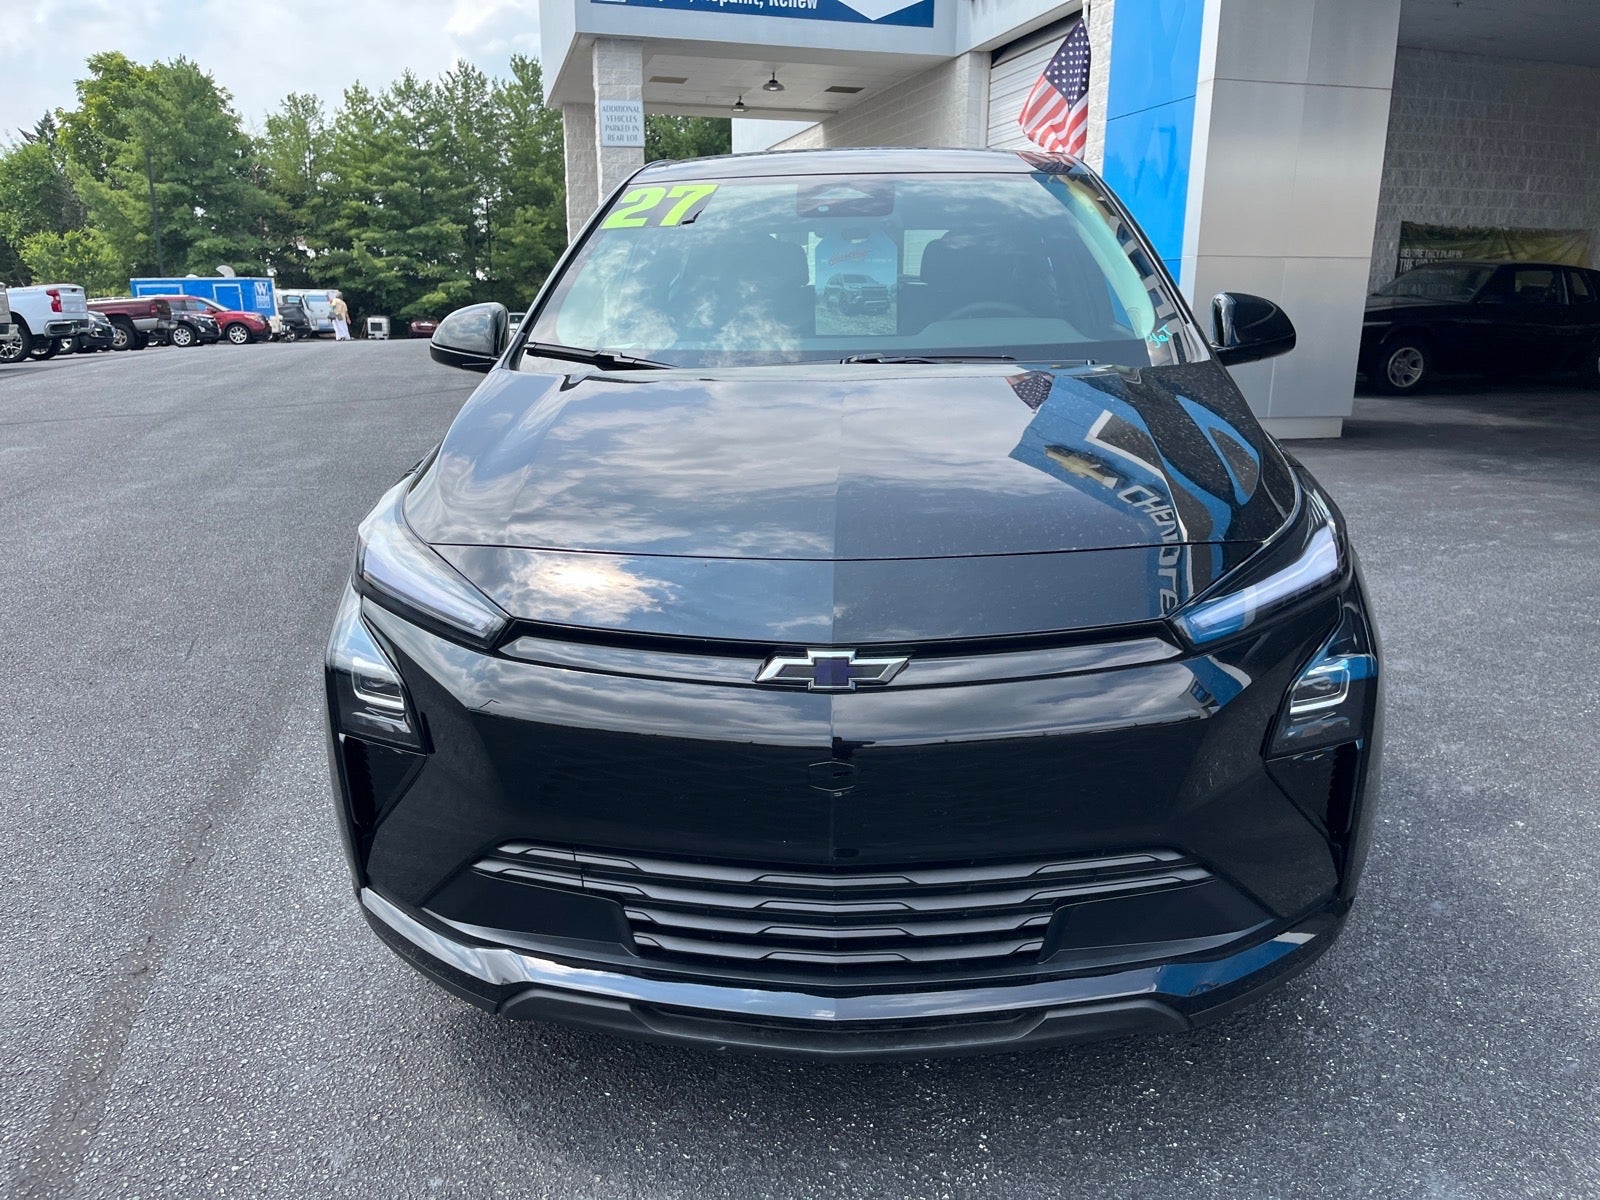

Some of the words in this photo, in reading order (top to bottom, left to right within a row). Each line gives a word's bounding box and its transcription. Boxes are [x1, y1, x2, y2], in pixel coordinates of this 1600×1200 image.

[602, 105, 640, 113] ADDITIONAL
[606, 115, 638, 123] VEHICLES
[605, 124, 630, 132] PARKED
[607, 134, 625, 142] REAR
[627, 134, 638, 142] LOT
[601, 184, 719, 229] 27
